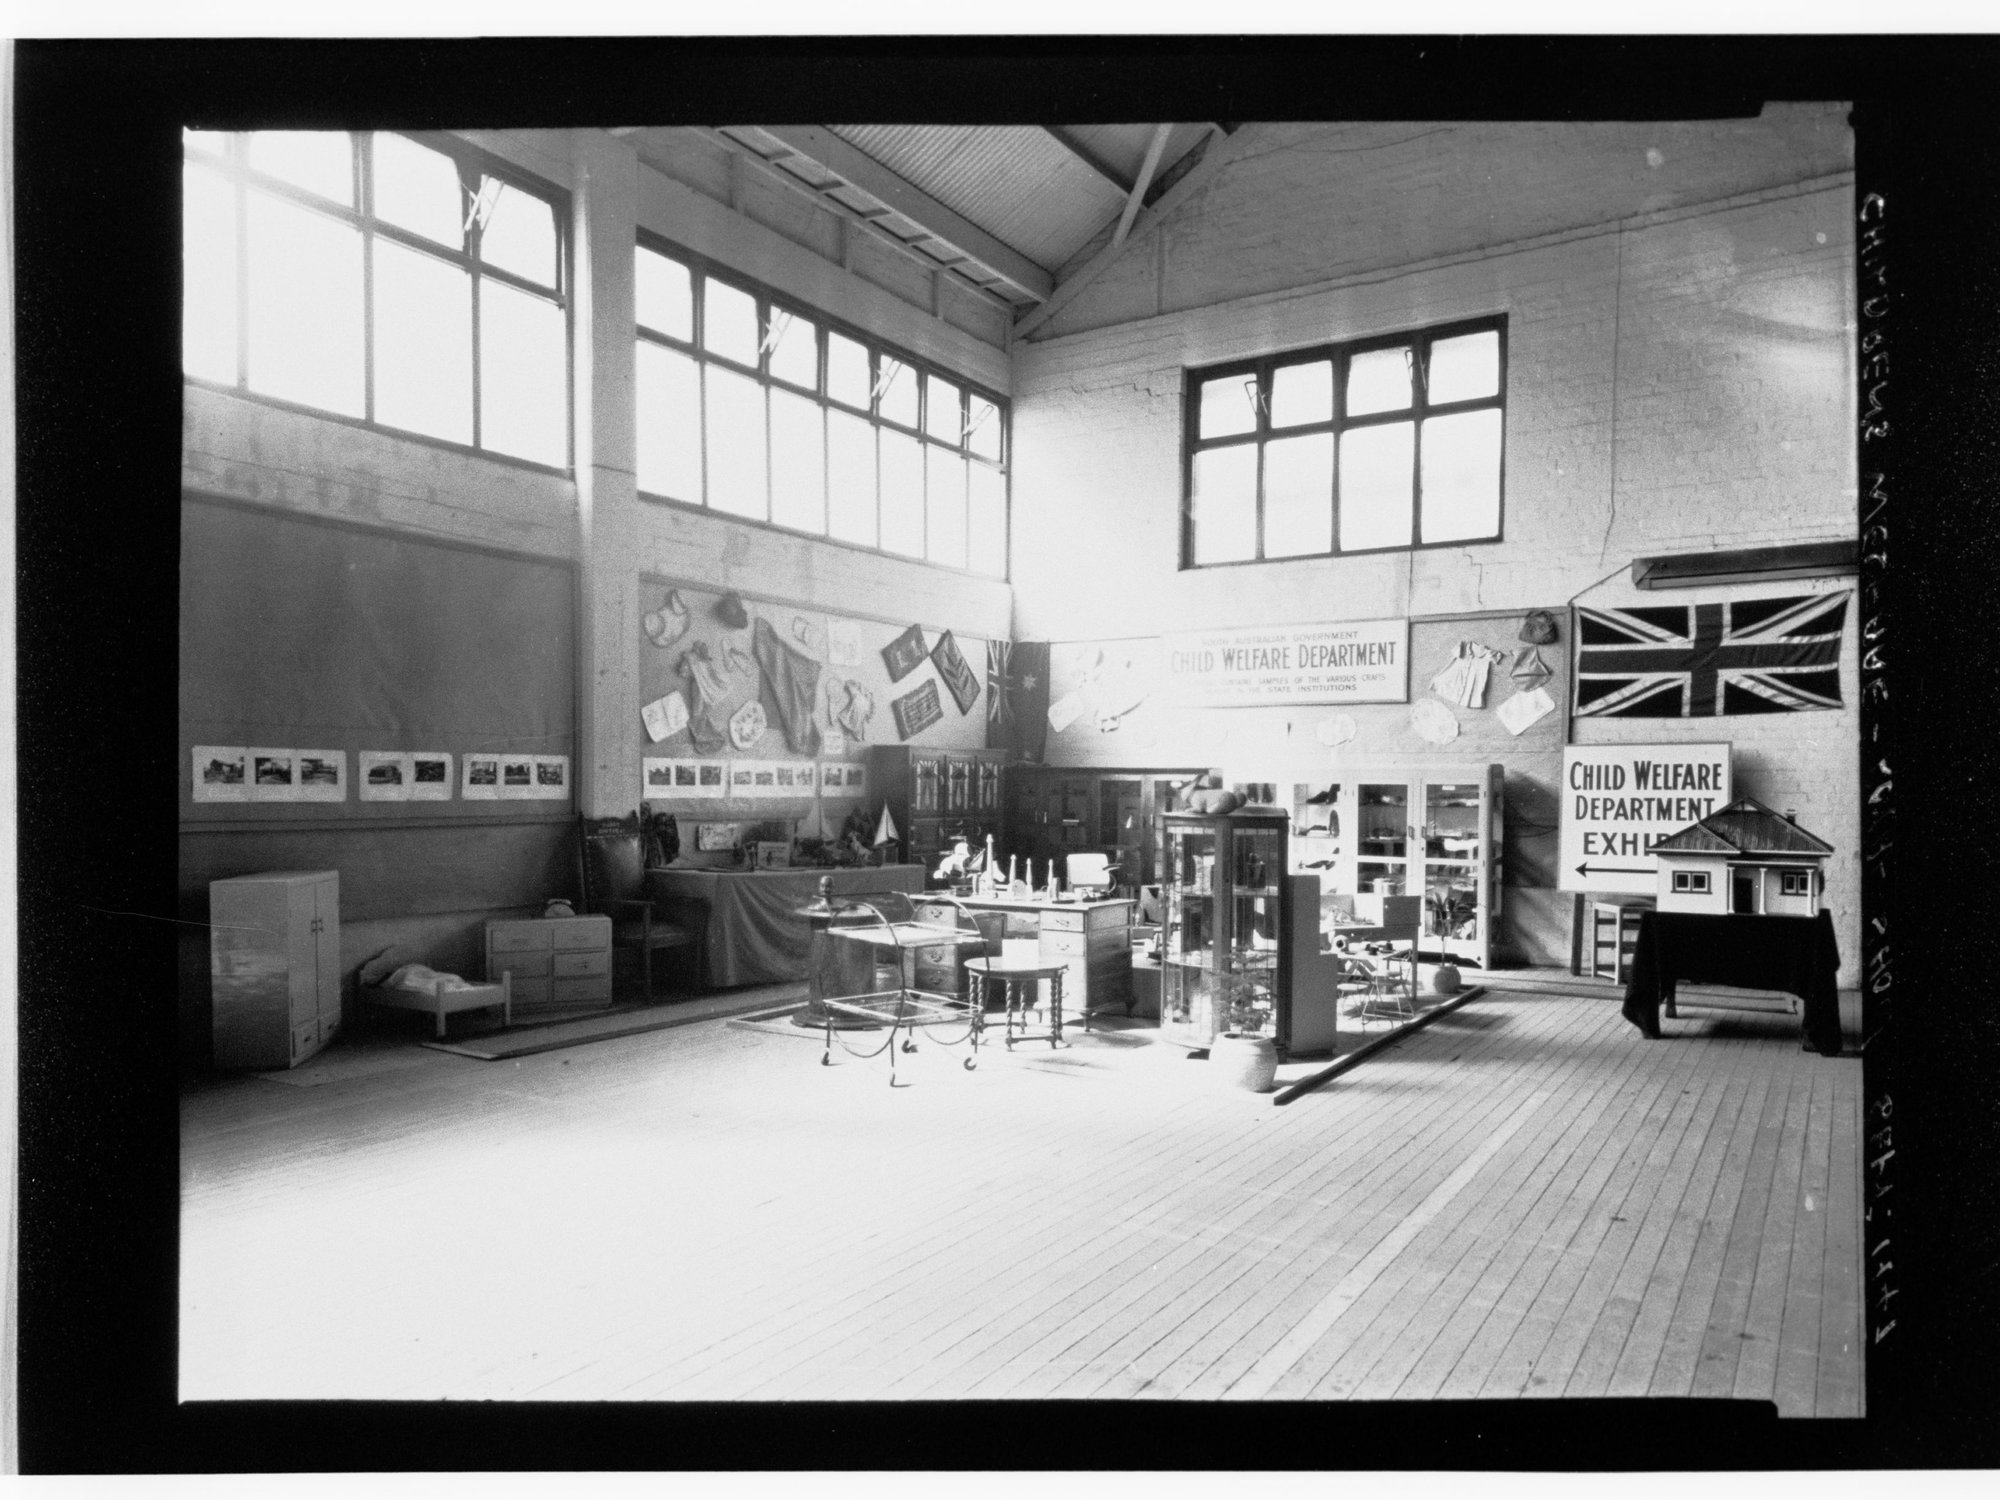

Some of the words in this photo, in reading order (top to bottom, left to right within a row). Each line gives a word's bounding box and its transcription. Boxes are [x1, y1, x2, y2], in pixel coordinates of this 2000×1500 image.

[1234, 634, 1287, 645] AUSTRALIAN
[1293, 630, 1359, 642] GOVERNMENT
[1170, 649, 1215, 673] CHILD
[1222, 647, 1291, 671] WELFARE
[1298, 641, 1397, 669] DEPARTMENT
[1267, 685, 1291, 693] STATE
[1297, 683, 1358, 692] INSTITUTIONS
[1295, 675, 1303, 683] OF
[1308, 675, 1320, 683] THE
[1326, 674, 1357, 683] VARIOUS
[1362, 673, 1386, 682] CRAFTS
[1570, 761, 1626, 791] CHILD
[1633, 760, 1722, 791] WELFARE
[1575, 795, 1715, 822] DEPARTMENT
